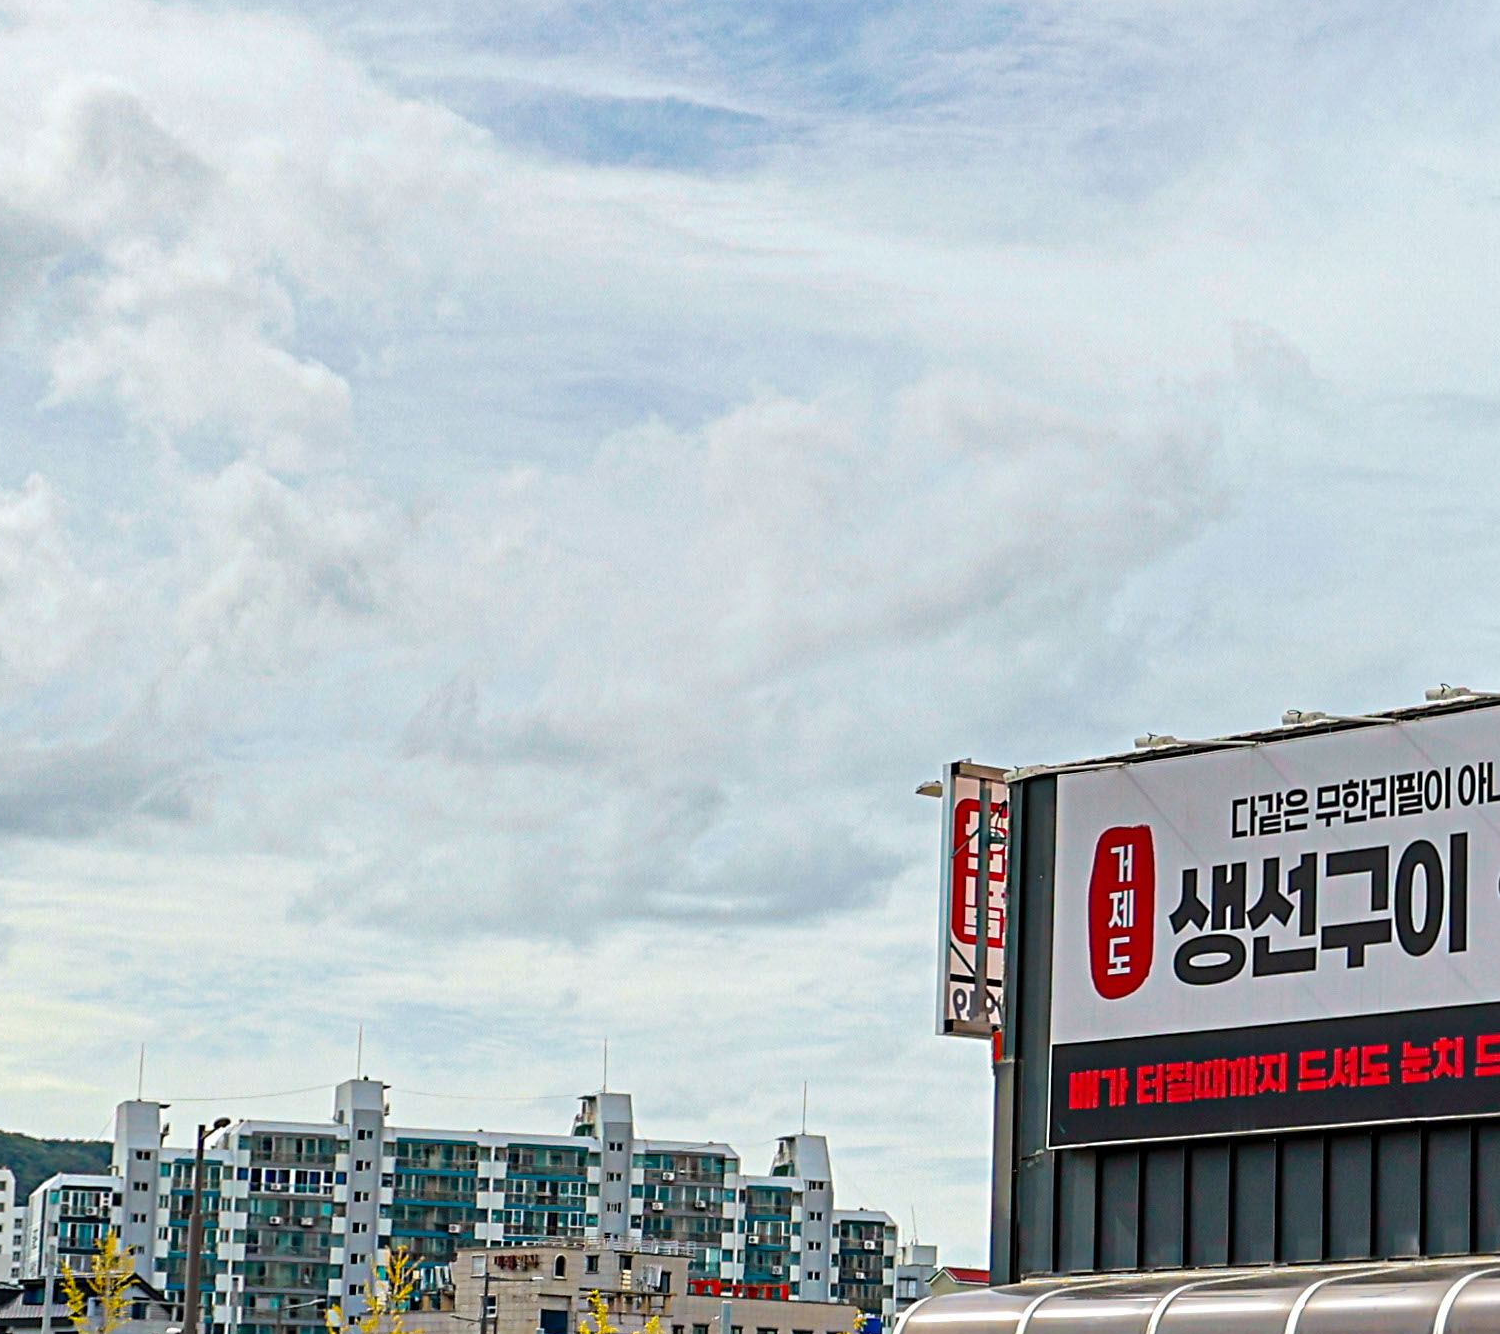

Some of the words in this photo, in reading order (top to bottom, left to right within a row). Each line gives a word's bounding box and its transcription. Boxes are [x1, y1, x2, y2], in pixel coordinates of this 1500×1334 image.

[1232, 789, 1308, 838] 다같은
[1315, 767, 1451, 826] 무한리필이
[1108, 844, 1134, 976] 거제도
[1168, 832, 1469, 985] 생선구이
[1068, 1067, 1129, 1110] 배가
[1137, 1052, 1288, 1107] 터질때까지
[1297, 1043, 1391, 1092] 드셔도
[1400, 1036, 1465, 1084] 눈치
